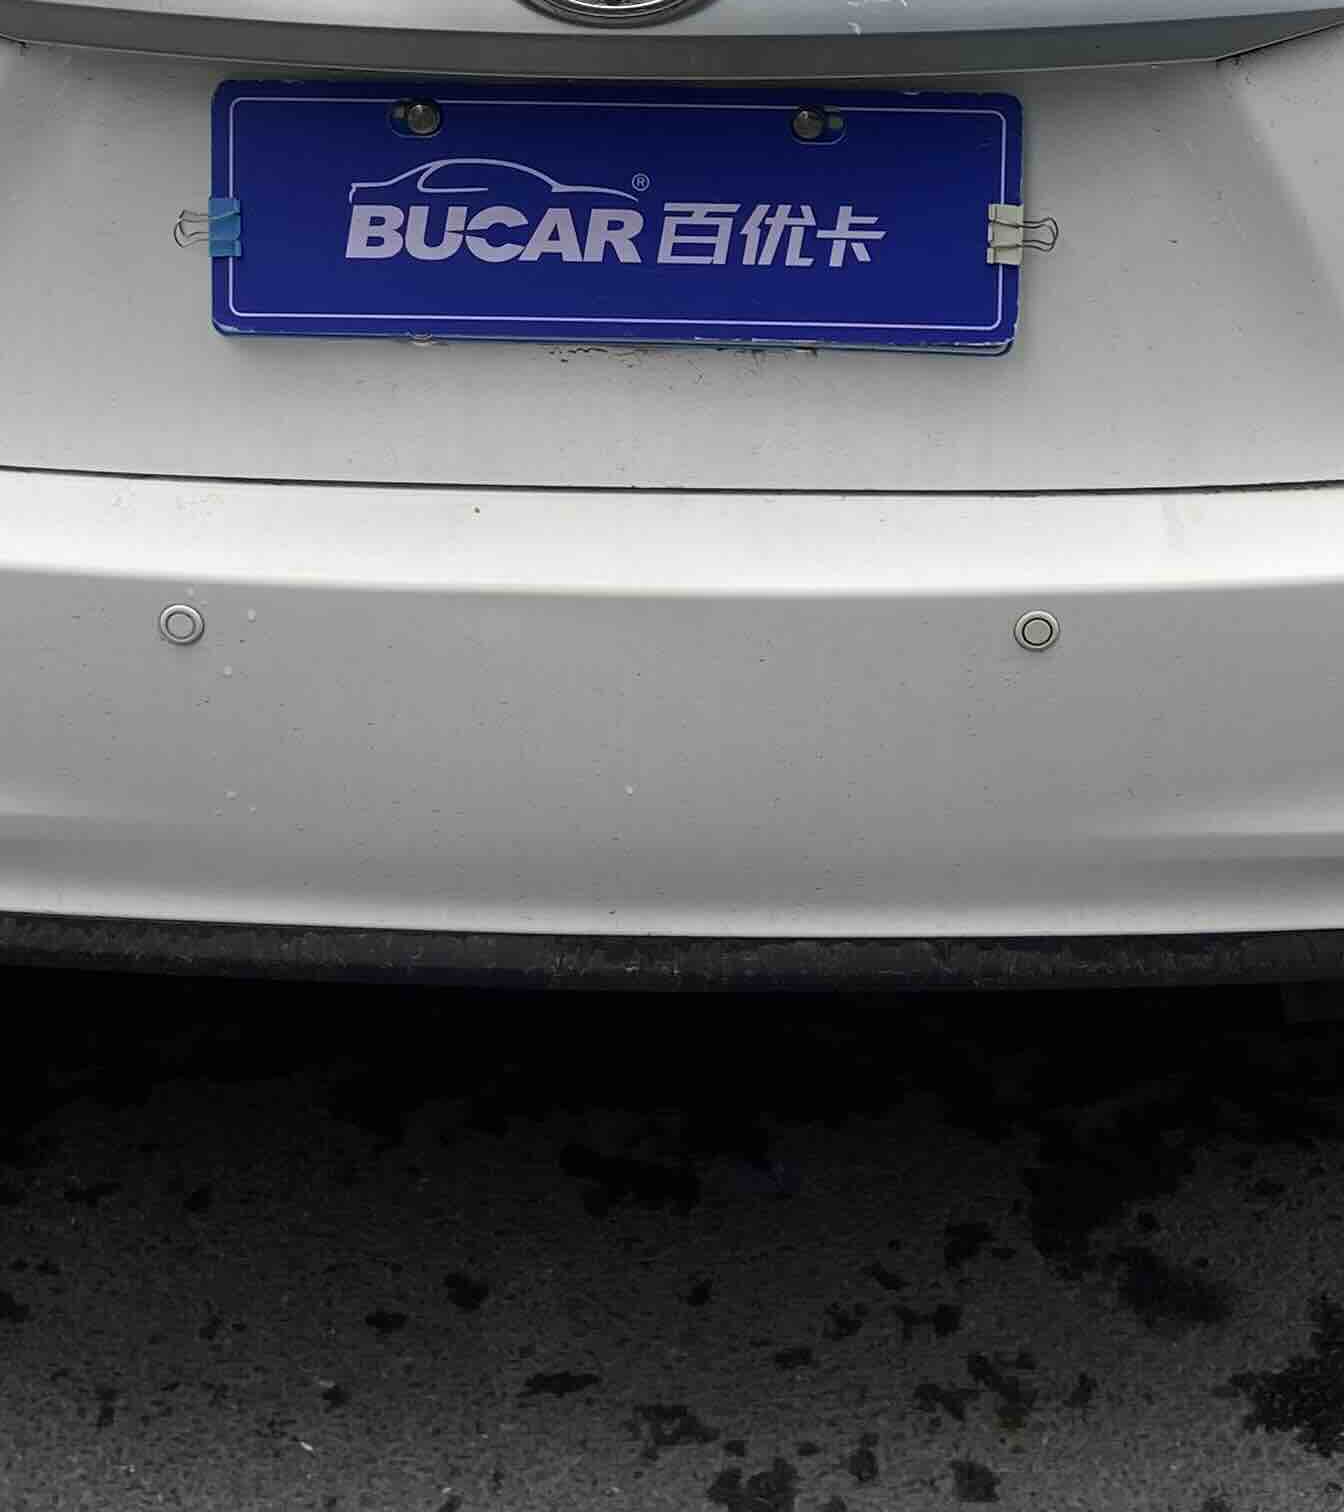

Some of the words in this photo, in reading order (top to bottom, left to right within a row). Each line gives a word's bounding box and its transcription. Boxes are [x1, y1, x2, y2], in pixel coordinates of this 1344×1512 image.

[344, 202, 644, 264] BUCAR
[657, 201, 886, 269] 百优卡
